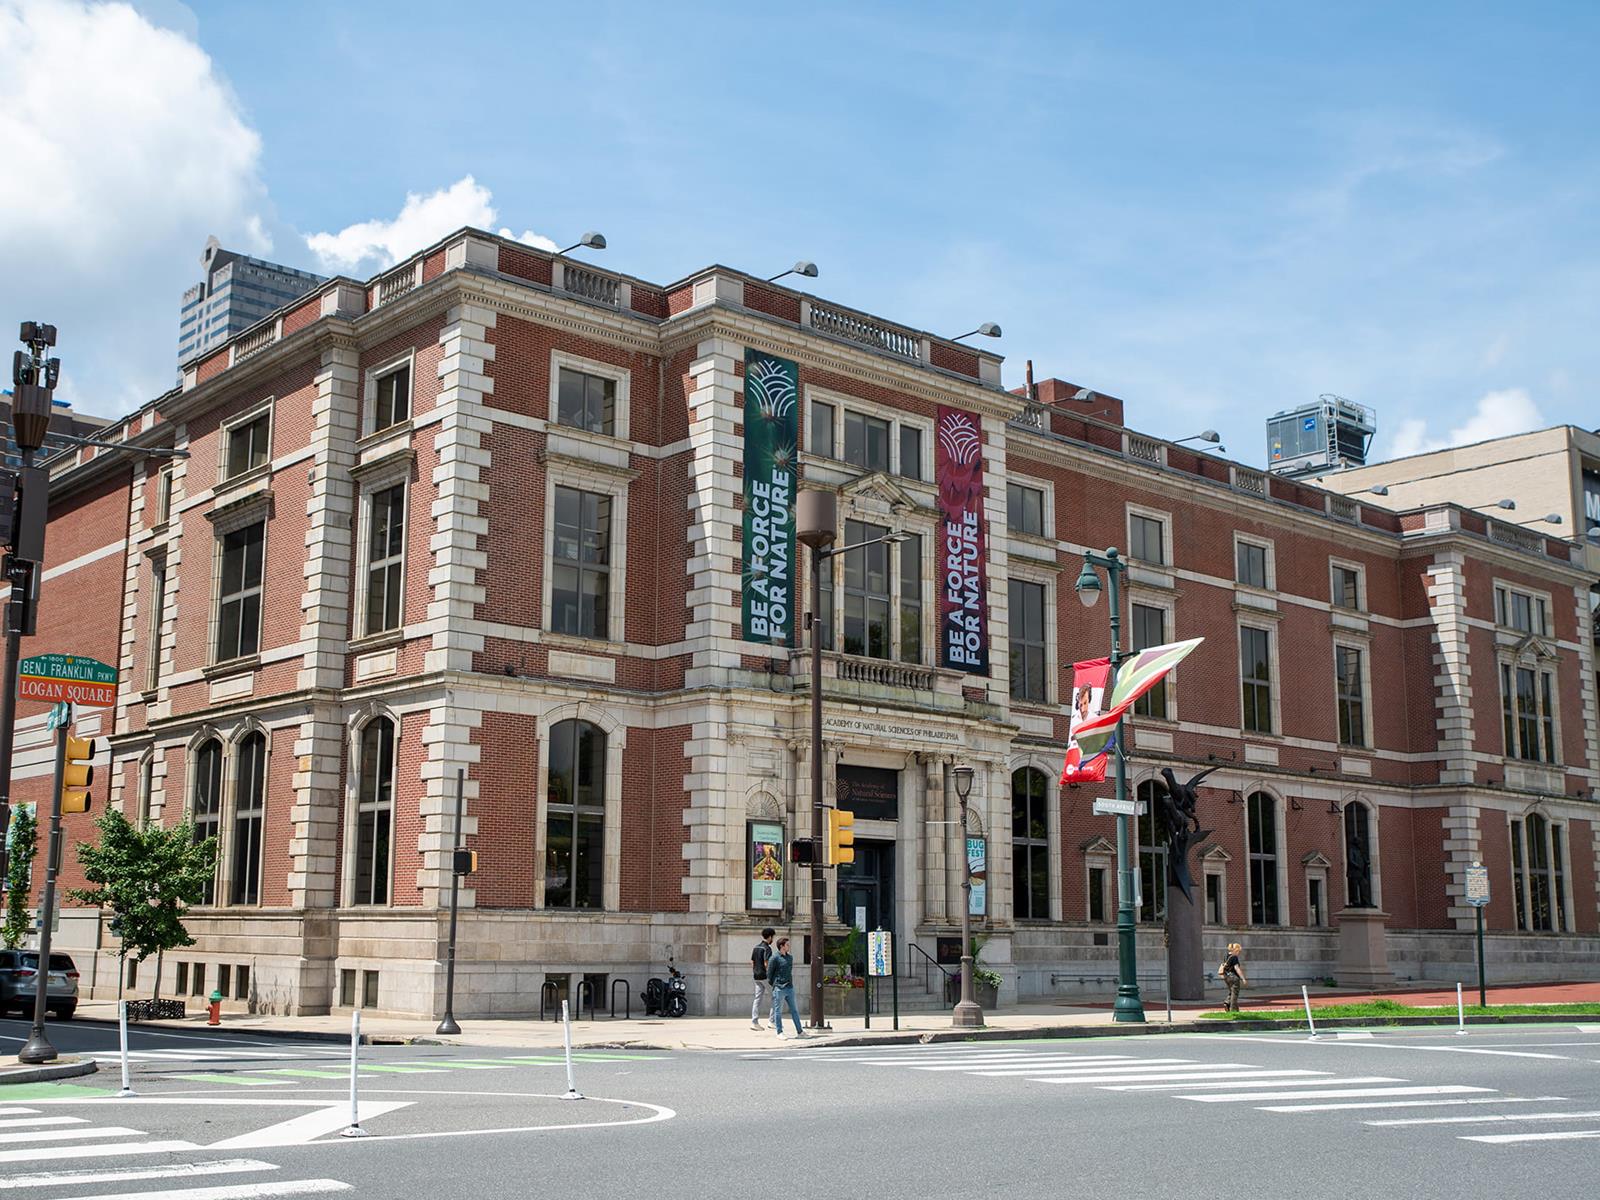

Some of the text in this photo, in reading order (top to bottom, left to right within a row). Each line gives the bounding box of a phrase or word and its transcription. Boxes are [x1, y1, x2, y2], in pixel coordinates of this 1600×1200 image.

[751, 479, 770, 636] BE A FORCE
[769, 469, 789, 639] FOR NATURE
[947, 521, 965, 663] BE A FORCE
[963, 510, 980, 665] FOR NATURE
[22, 660, 114, 681] BENJ FRANKLIN PKWY
[21, 680, 112, 702] LOGAN SQUARE
[825, 718, 853, 728] ACADEMY
[862, 722, 887, 732] NATURAL
[888, 725, 914, 735] SCIENCES
[914, 728, 922, 736] OF
[922, 730, 959, 740] PHILADELPHIA
[967, 840, 984, 849] BUG
[967, 849, 984, 857] FEST
